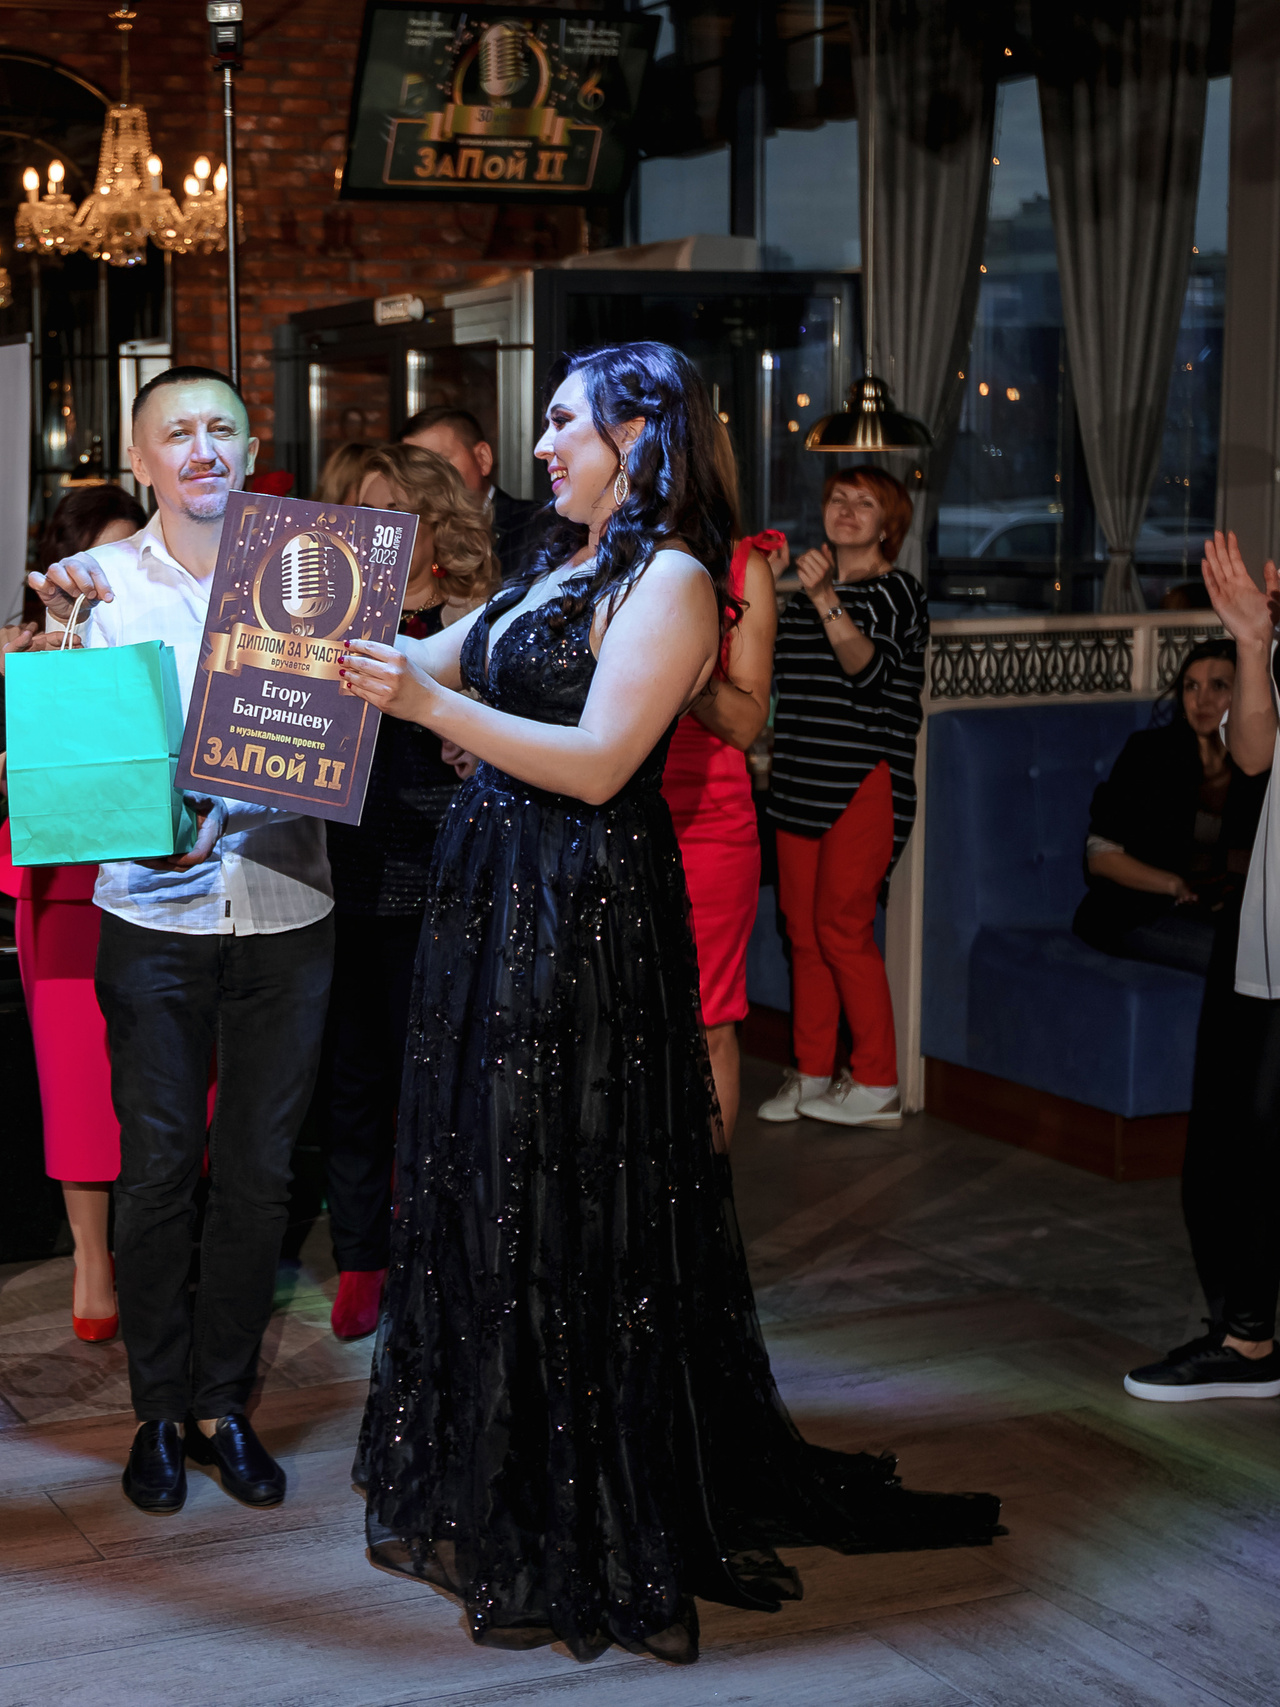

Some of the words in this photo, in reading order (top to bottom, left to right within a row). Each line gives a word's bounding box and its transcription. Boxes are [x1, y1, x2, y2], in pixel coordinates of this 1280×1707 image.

[372, 524, 395, 548] 30
[392, 526, 404, 551] АПРЕЛЯ
[368, 547, 398, 566] 2023
[236, 632, 286, 656] ДИПЛОМ
[287, 641, 302, 658] ЗА
[304, 643, 354, 664] УЧАСТИ
[270, 657, 311, 672] вручается
[261, 680, 311, 710] Егору
[232, 696, 333, 736] Багрянцеву
[229, 725, 235, 733] в
[235, 726, 292, 744] музыкальном
[292, 737, 326, 751] проекте
[313, 757, 346, 790] II
